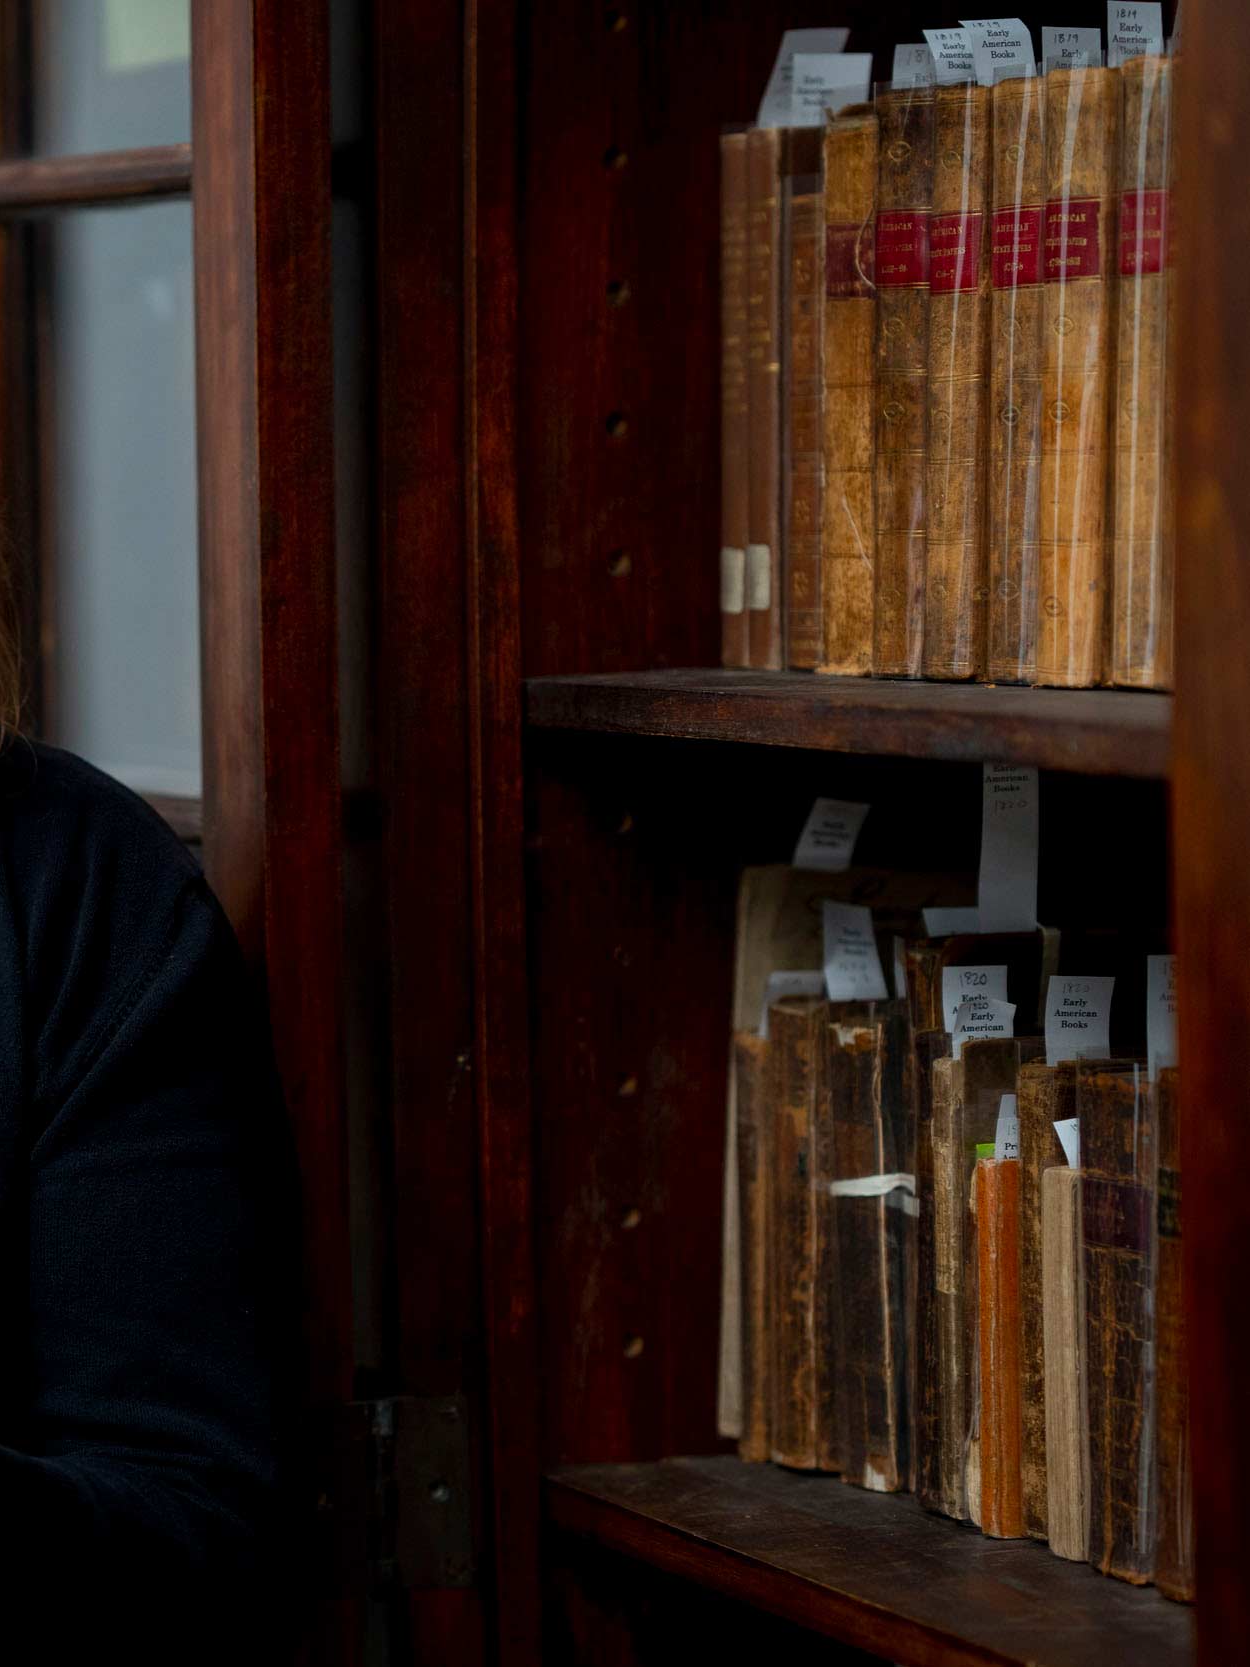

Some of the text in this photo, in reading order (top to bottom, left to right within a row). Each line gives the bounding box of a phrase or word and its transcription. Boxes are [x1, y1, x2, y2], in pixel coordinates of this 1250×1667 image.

[1117, 8, 1137, 19] 1819
[987, 29, 1010, 38] Early
[1119, 24, 1143, 34] Early
[935, 32, 962, 40] 1819
[1054, 33, 1079, 44] 1819
[1112, 35, 1153, 44] American
[943, 43, 966, 51] Early
[982, 40, 1022, 48] American
[991, 51, 1016, 59] Books
[1061, 49, 1084, 59] Early
[947, 62, 972, 70] Books
[959, 971, 988, 987] 1820
[1063, 998, 1088, 1007] Early
[971, 1013, 995, 1021] Early
[1054, 1009, 1098, 1018] American
[960, 1025, 1004, 1033] American
[1061, 1020, 1089, 1029] Books
